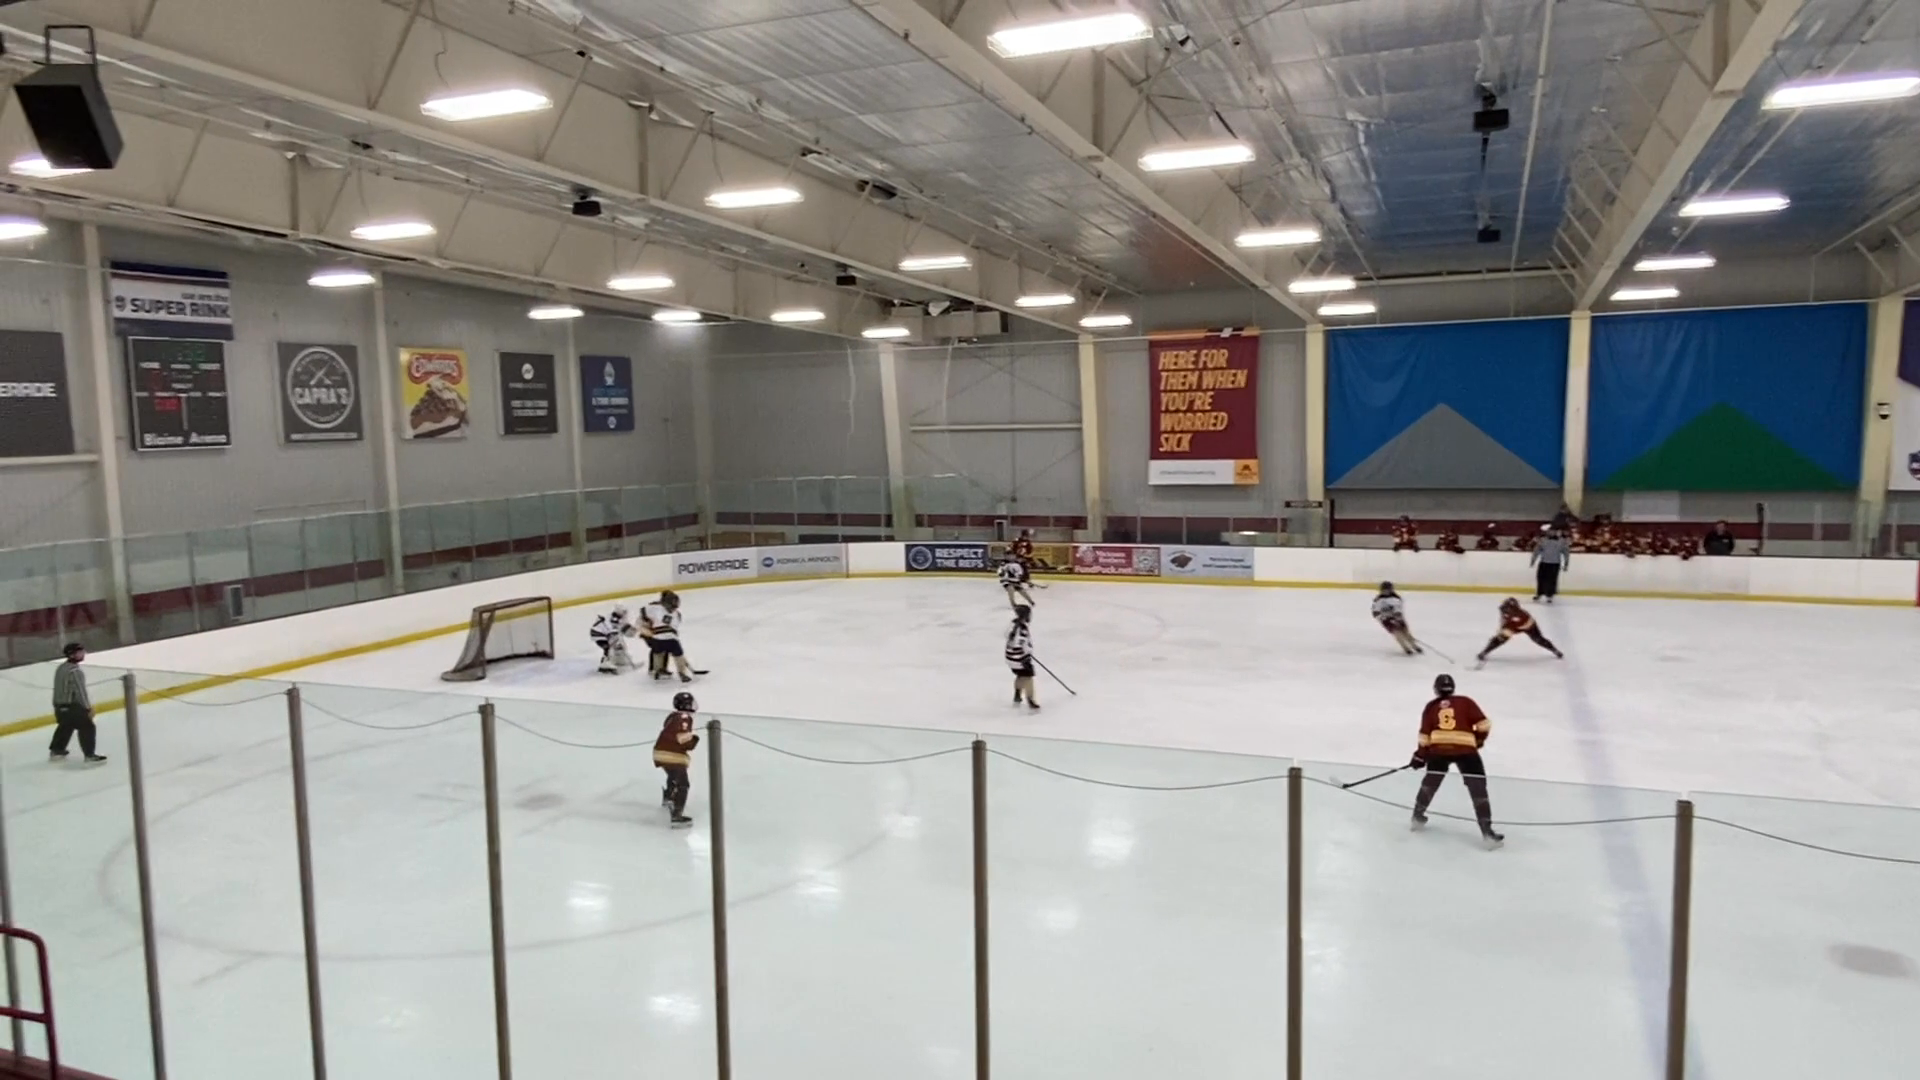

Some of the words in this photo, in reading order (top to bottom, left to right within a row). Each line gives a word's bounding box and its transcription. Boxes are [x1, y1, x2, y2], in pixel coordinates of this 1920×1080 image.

[130, 297, 187, 316] SUPER
[190, 302, 231, 318] RINK
[1159, 351, 1198, 370] HERE
[1200, 349, 1228, 368] FOR
[1160, 371, 1199, 390] THEM
[1202, 369, 1248, 389] WHEN
[294, 387, 350, 405] CAPRA'S
[1160, 391, 1214, 411] YOU'RE
[1160, 412, 1229, 431] WORRIED
[1159, 433, 1193, 452] SICK
[776, 557, 807, 565] KONICA
[934, 548, 984, 558] RESPECT
[678, 558, 750, 575] POWERADE
[935, 559, 957, 568] THE
[958, 559, 984, 568] REFS
